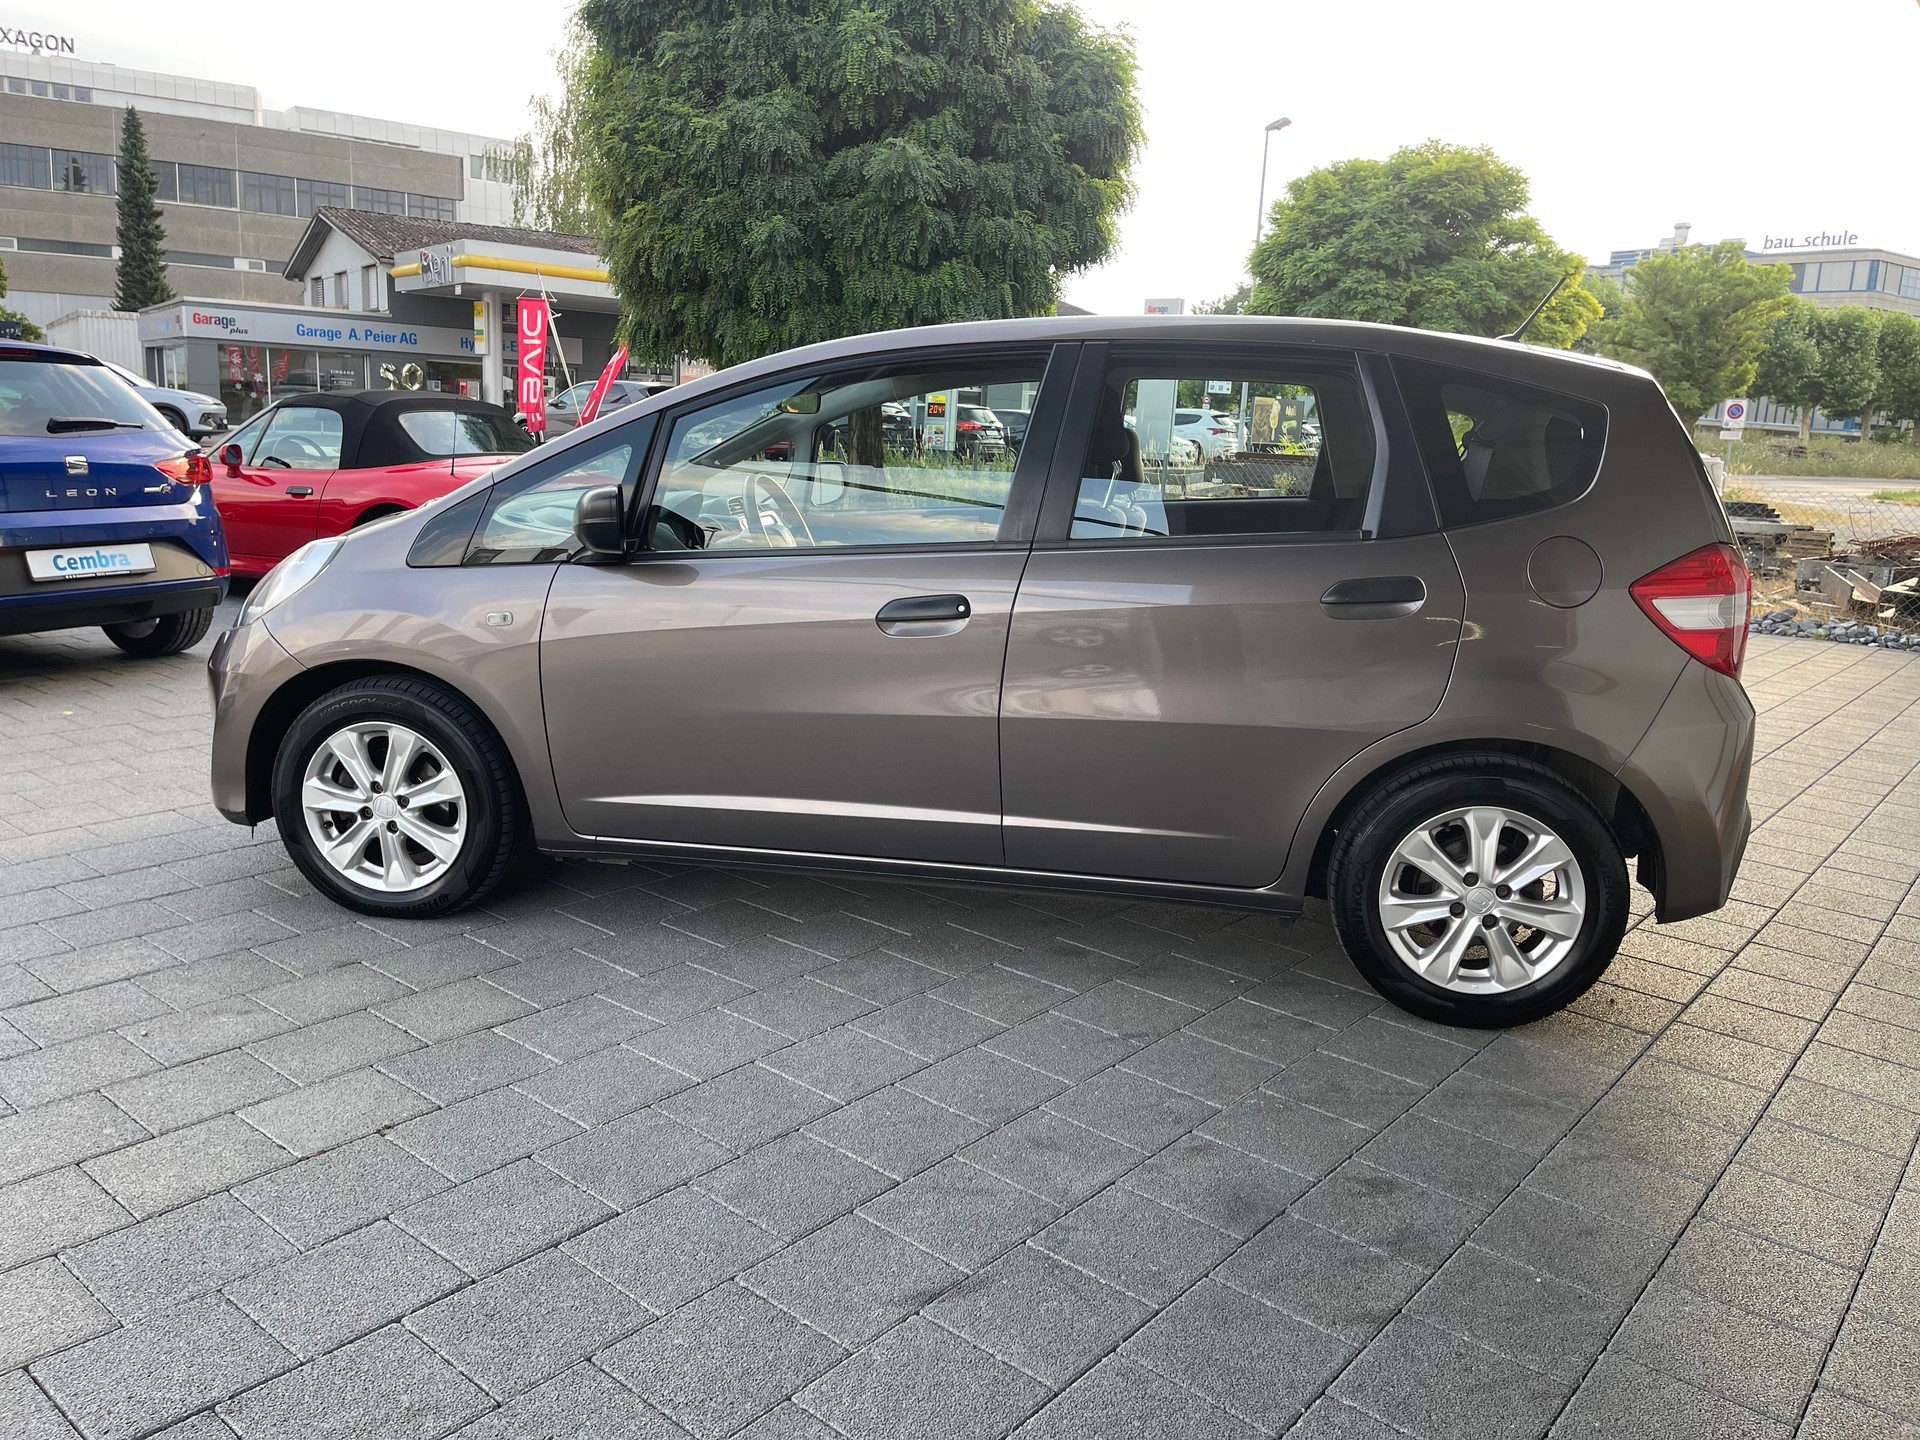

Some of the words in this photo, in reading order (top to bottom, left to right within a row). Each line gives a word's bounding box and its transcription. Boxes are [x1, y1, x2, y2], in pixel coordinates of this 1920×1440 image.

[0, 26, 75, 54] XAGON
[1148, 306, 1169, 315] Garage
[193, 312, 236, 329] Garage
[229, 327, 249, 335] plus
[296, 323, 342, 342] Garage
[348, 328, 361, 341] A.
[364, 329, 397, 344] Peier
[399, 332, 418, 346] AG
[522, 308, 542, 404] BAIC
[46, 487, 117, 498] LEON
[52, 551, 131, 572] Cembra
